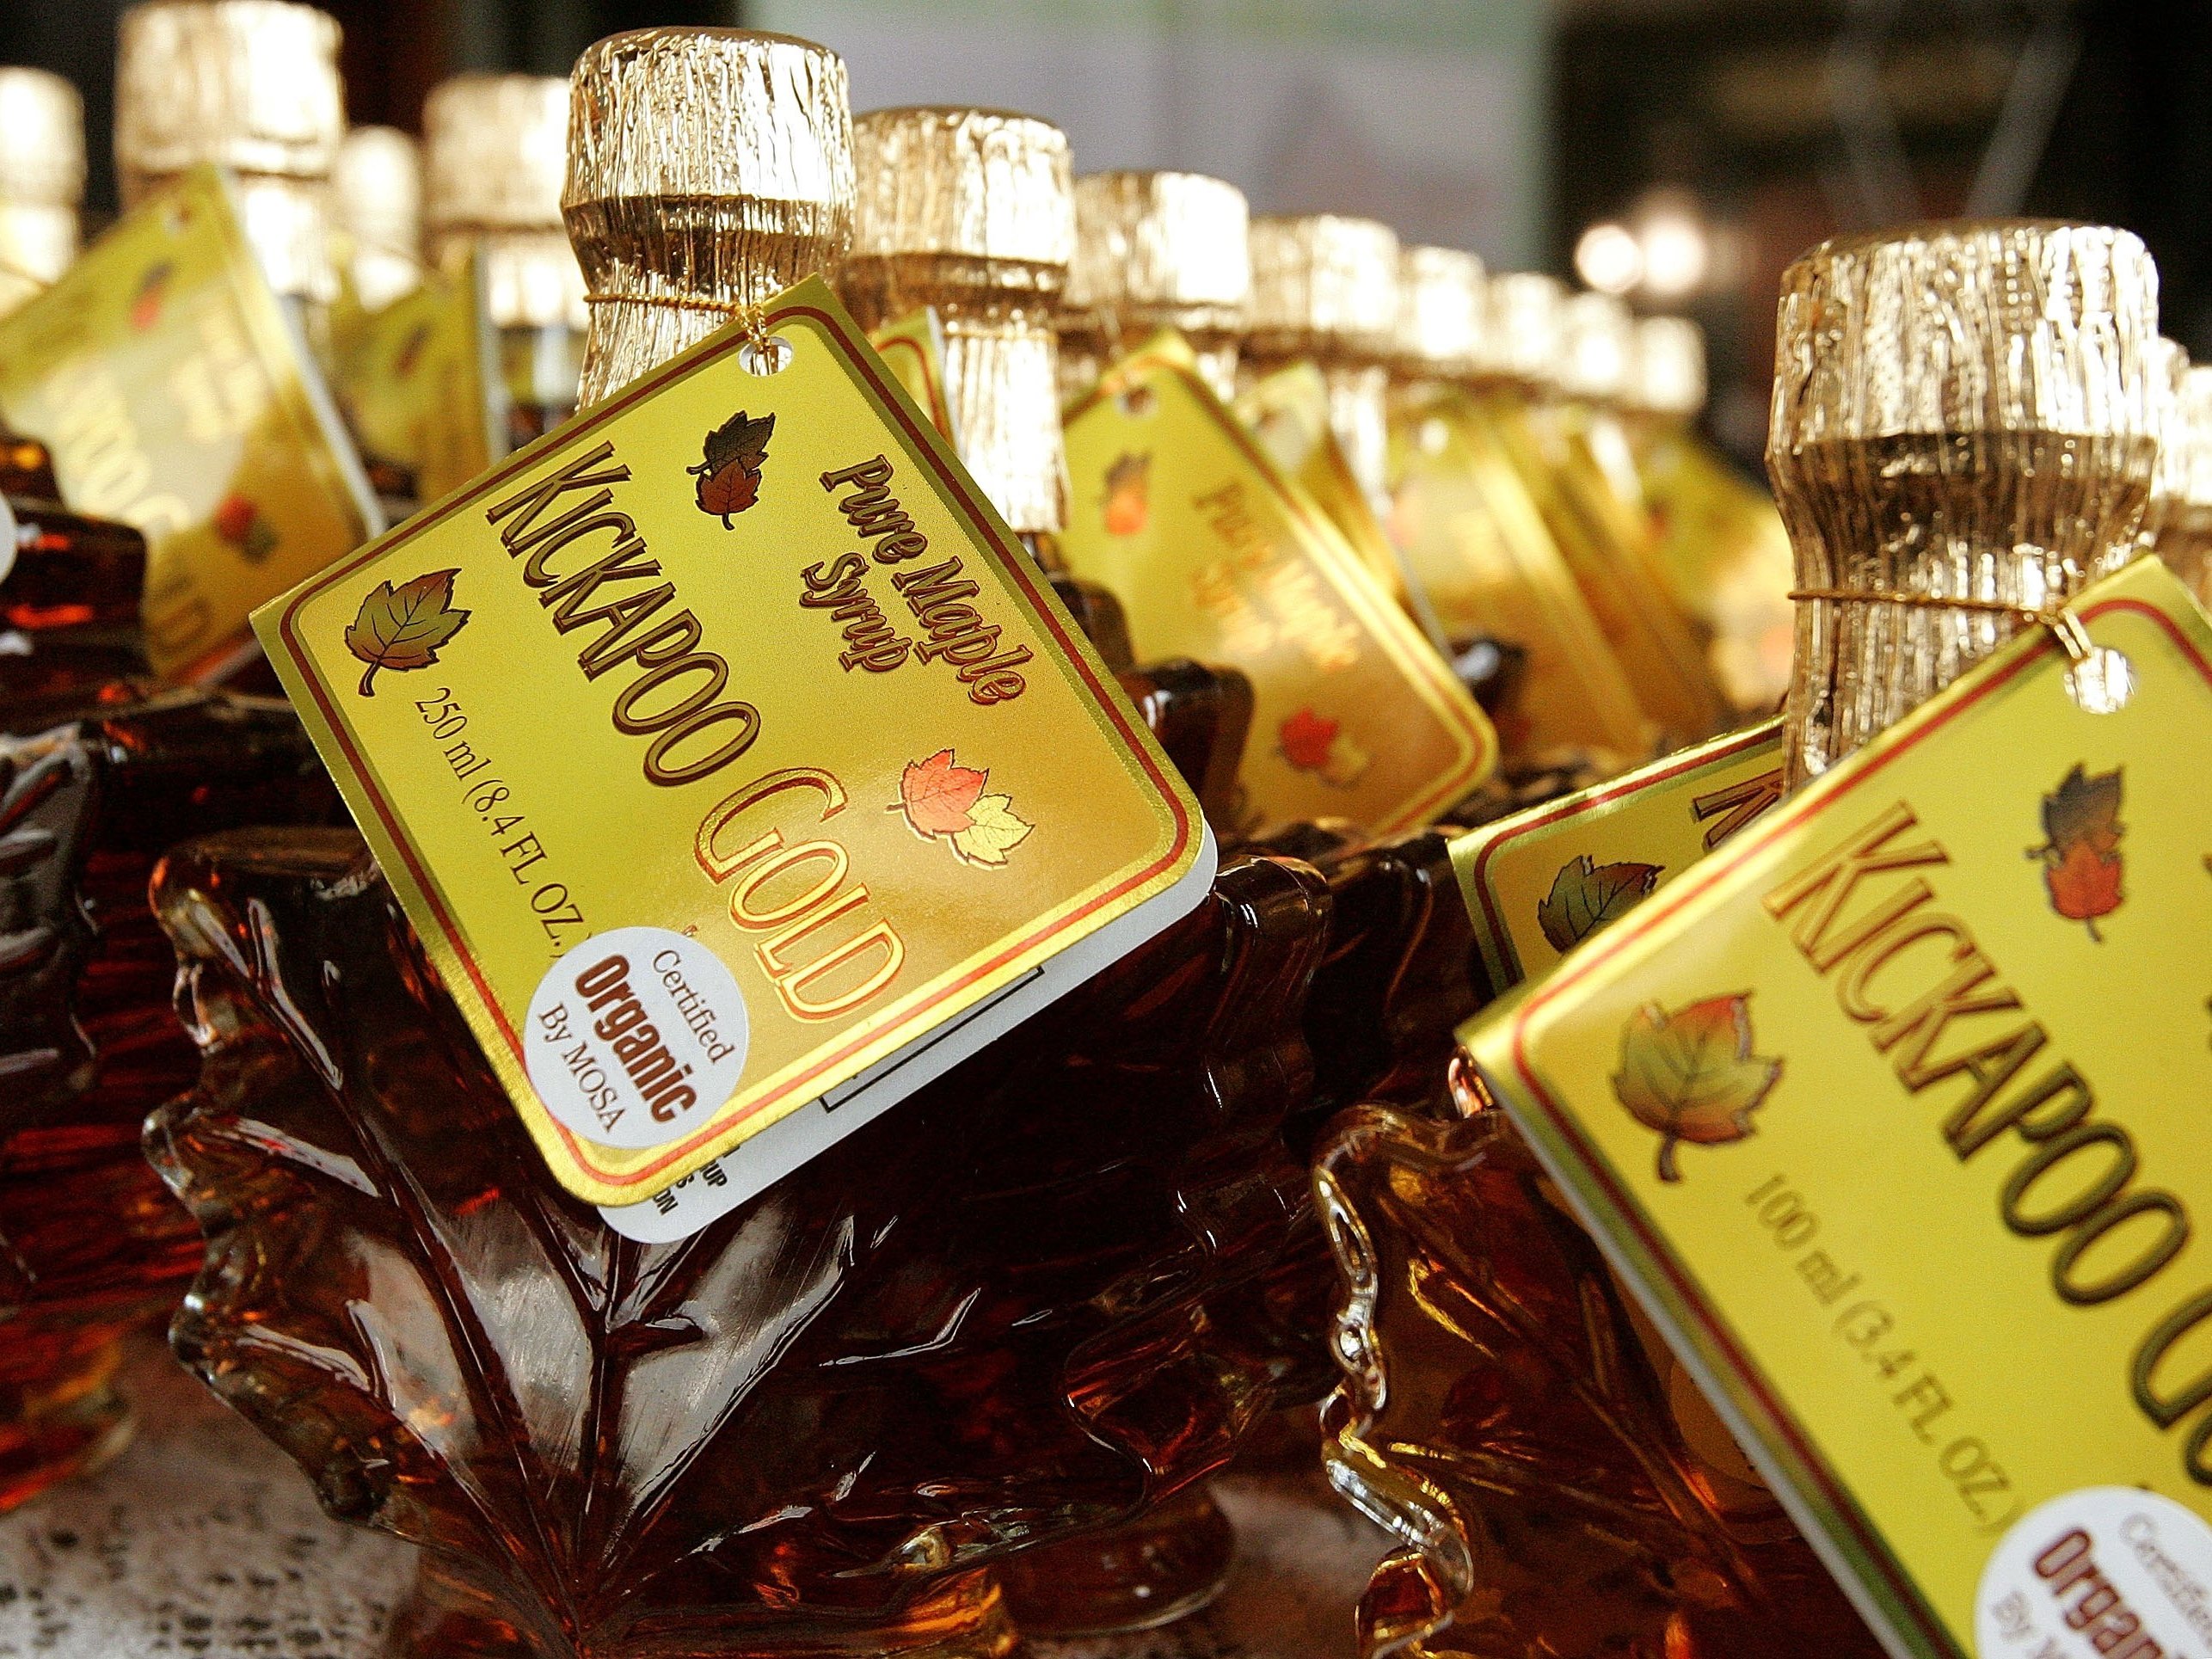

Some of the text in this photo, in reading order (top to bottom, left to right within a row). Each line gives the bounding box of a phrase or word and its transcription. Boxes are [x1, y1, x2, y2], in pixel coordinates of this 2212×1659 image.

[799, 552, 912, 672] Syrup
[819, 454, 1034, 705] Pure Maple
[415, 687, 467, 740] 250
[443, 740, 492, 781] ml
[486, 440, 906, 1023] KICKAPOO GOLD
[461, 779, 525, 836] (8.4
[499, 831, 548, 885] FL
[538, 1001, 630, 1133] By MOSA
[575, 954, 697, 1124] Organic
[653, 949, 735, 1065] Certified
[1761, 800, 2190, 1307] KICKAPOO
[1746, 1174, 1821, 1250] 100
[1795, 1248, 1865, 1306] ml
[1831, 1299, 1916, 1383] (3.4
[1892, 1371, 1953, 1446] FL
